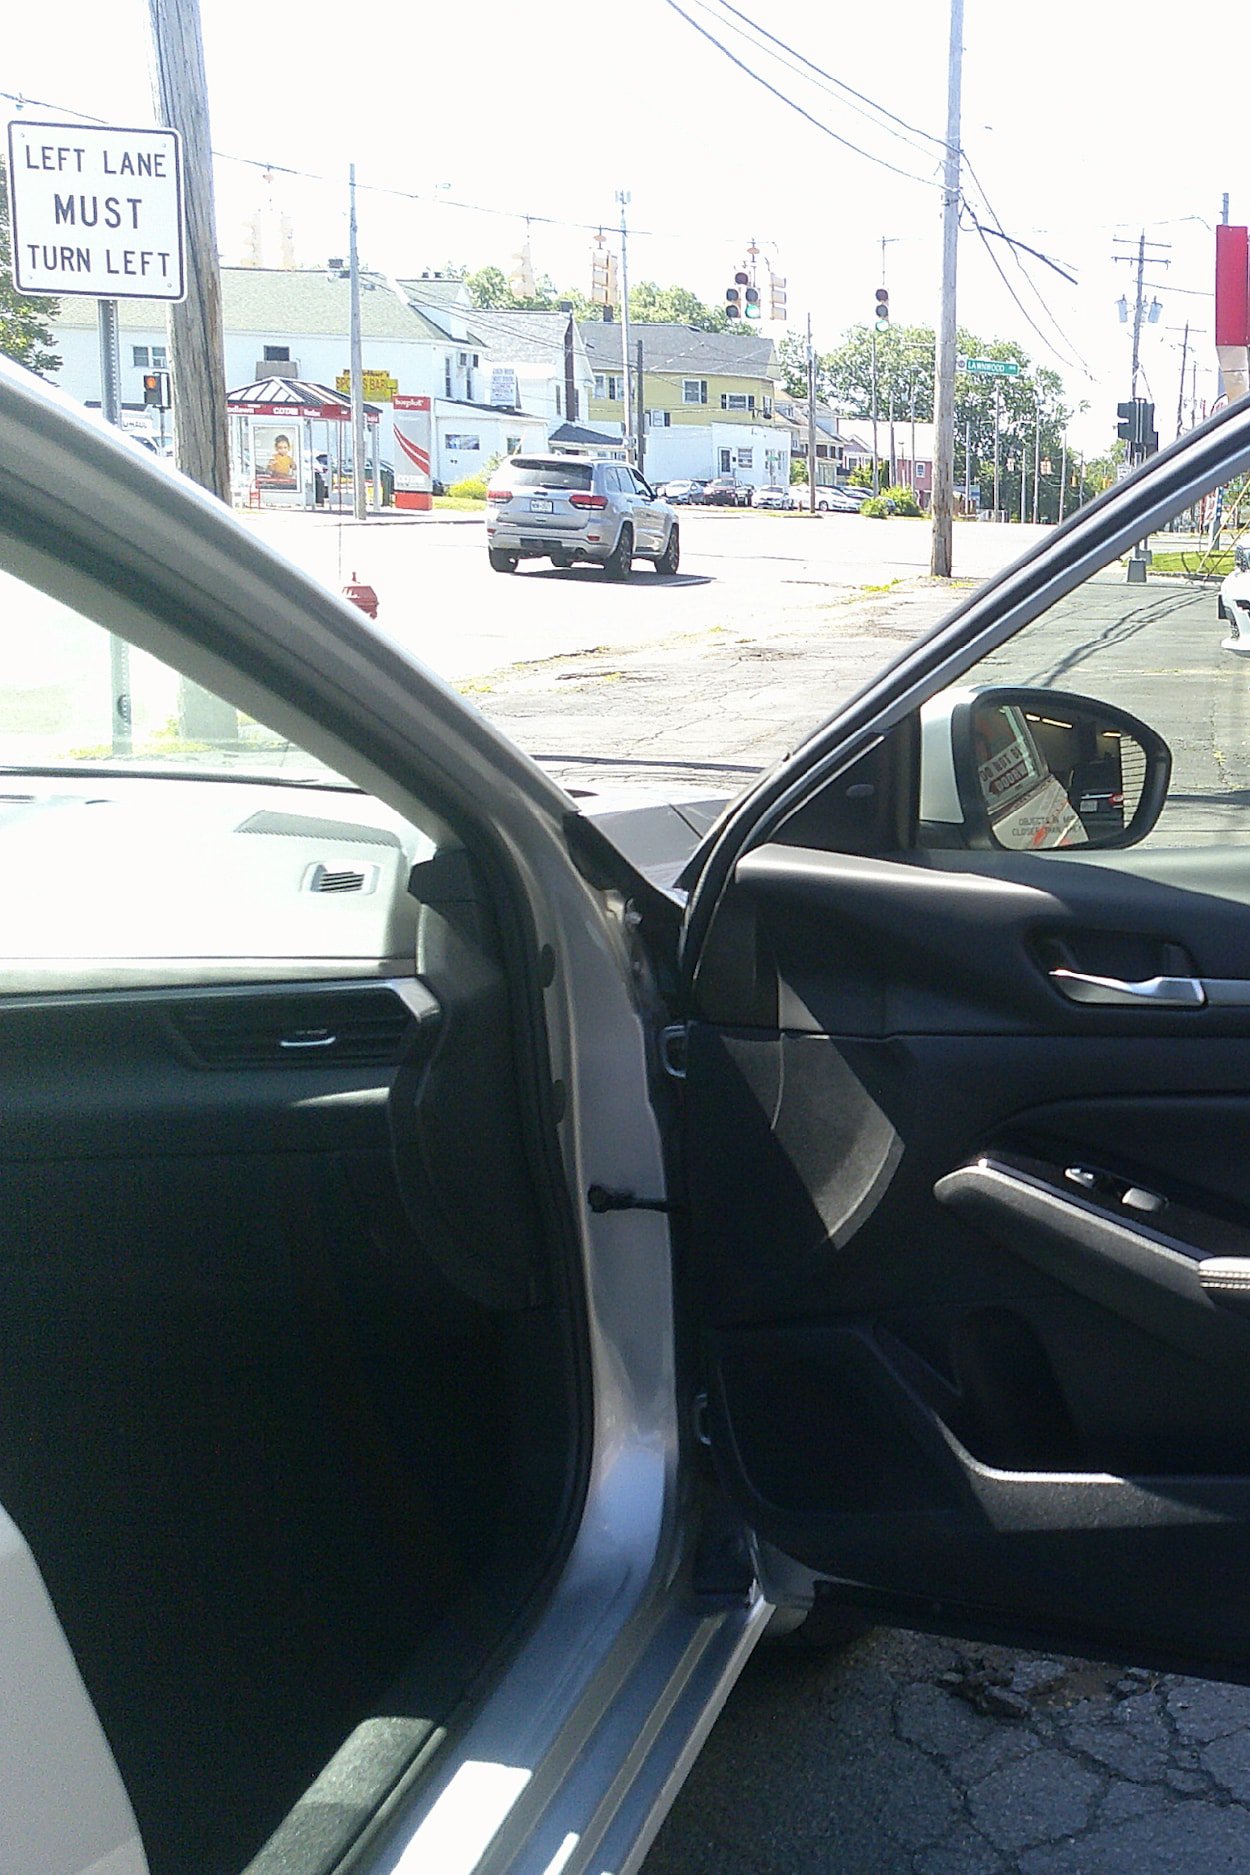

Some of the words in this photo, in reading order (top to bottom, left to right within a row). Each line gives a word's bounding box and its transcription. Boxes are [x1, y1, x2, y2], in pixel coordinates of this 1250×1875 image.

[26, 145, 85, 172] LEFT
[103, 150, 167, 178] LANE
[54, 193, 142, 229] MUST
[27, 244, 91, 273] TURN
[106, 249, 170, 277] LEFT
